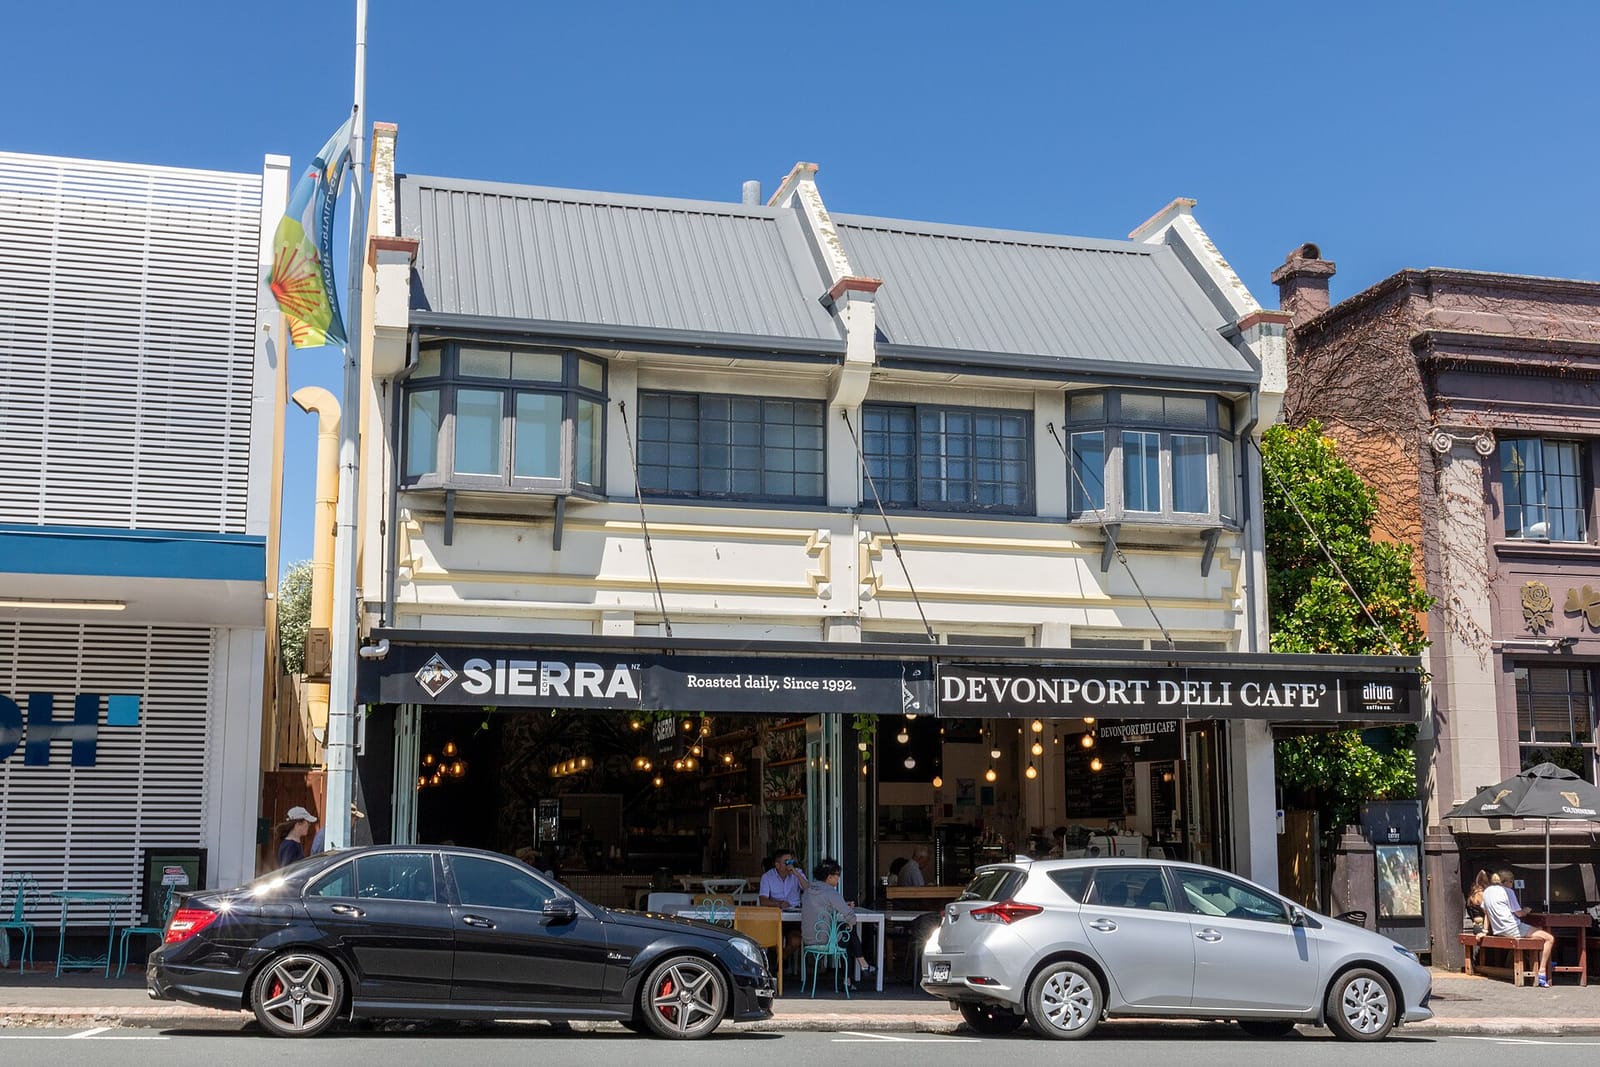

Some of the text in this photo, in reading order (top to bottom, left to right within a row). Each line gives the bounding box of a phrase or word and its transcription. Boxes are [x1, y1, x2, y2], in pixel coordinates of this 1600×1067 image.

[461, 658, 638, 699] SIERRA
[687, 675, 857, 692] Roasted daily. Since 1992.
[941, 676, 1150, 704] DEVONPORT
[1157, 680, 1232, 706] DELI
[1362, 682, 1393, 700] altura
[1100, 724, 1140, 738] DEVONPORT
[1140, 722, 1156, 735] DELI
